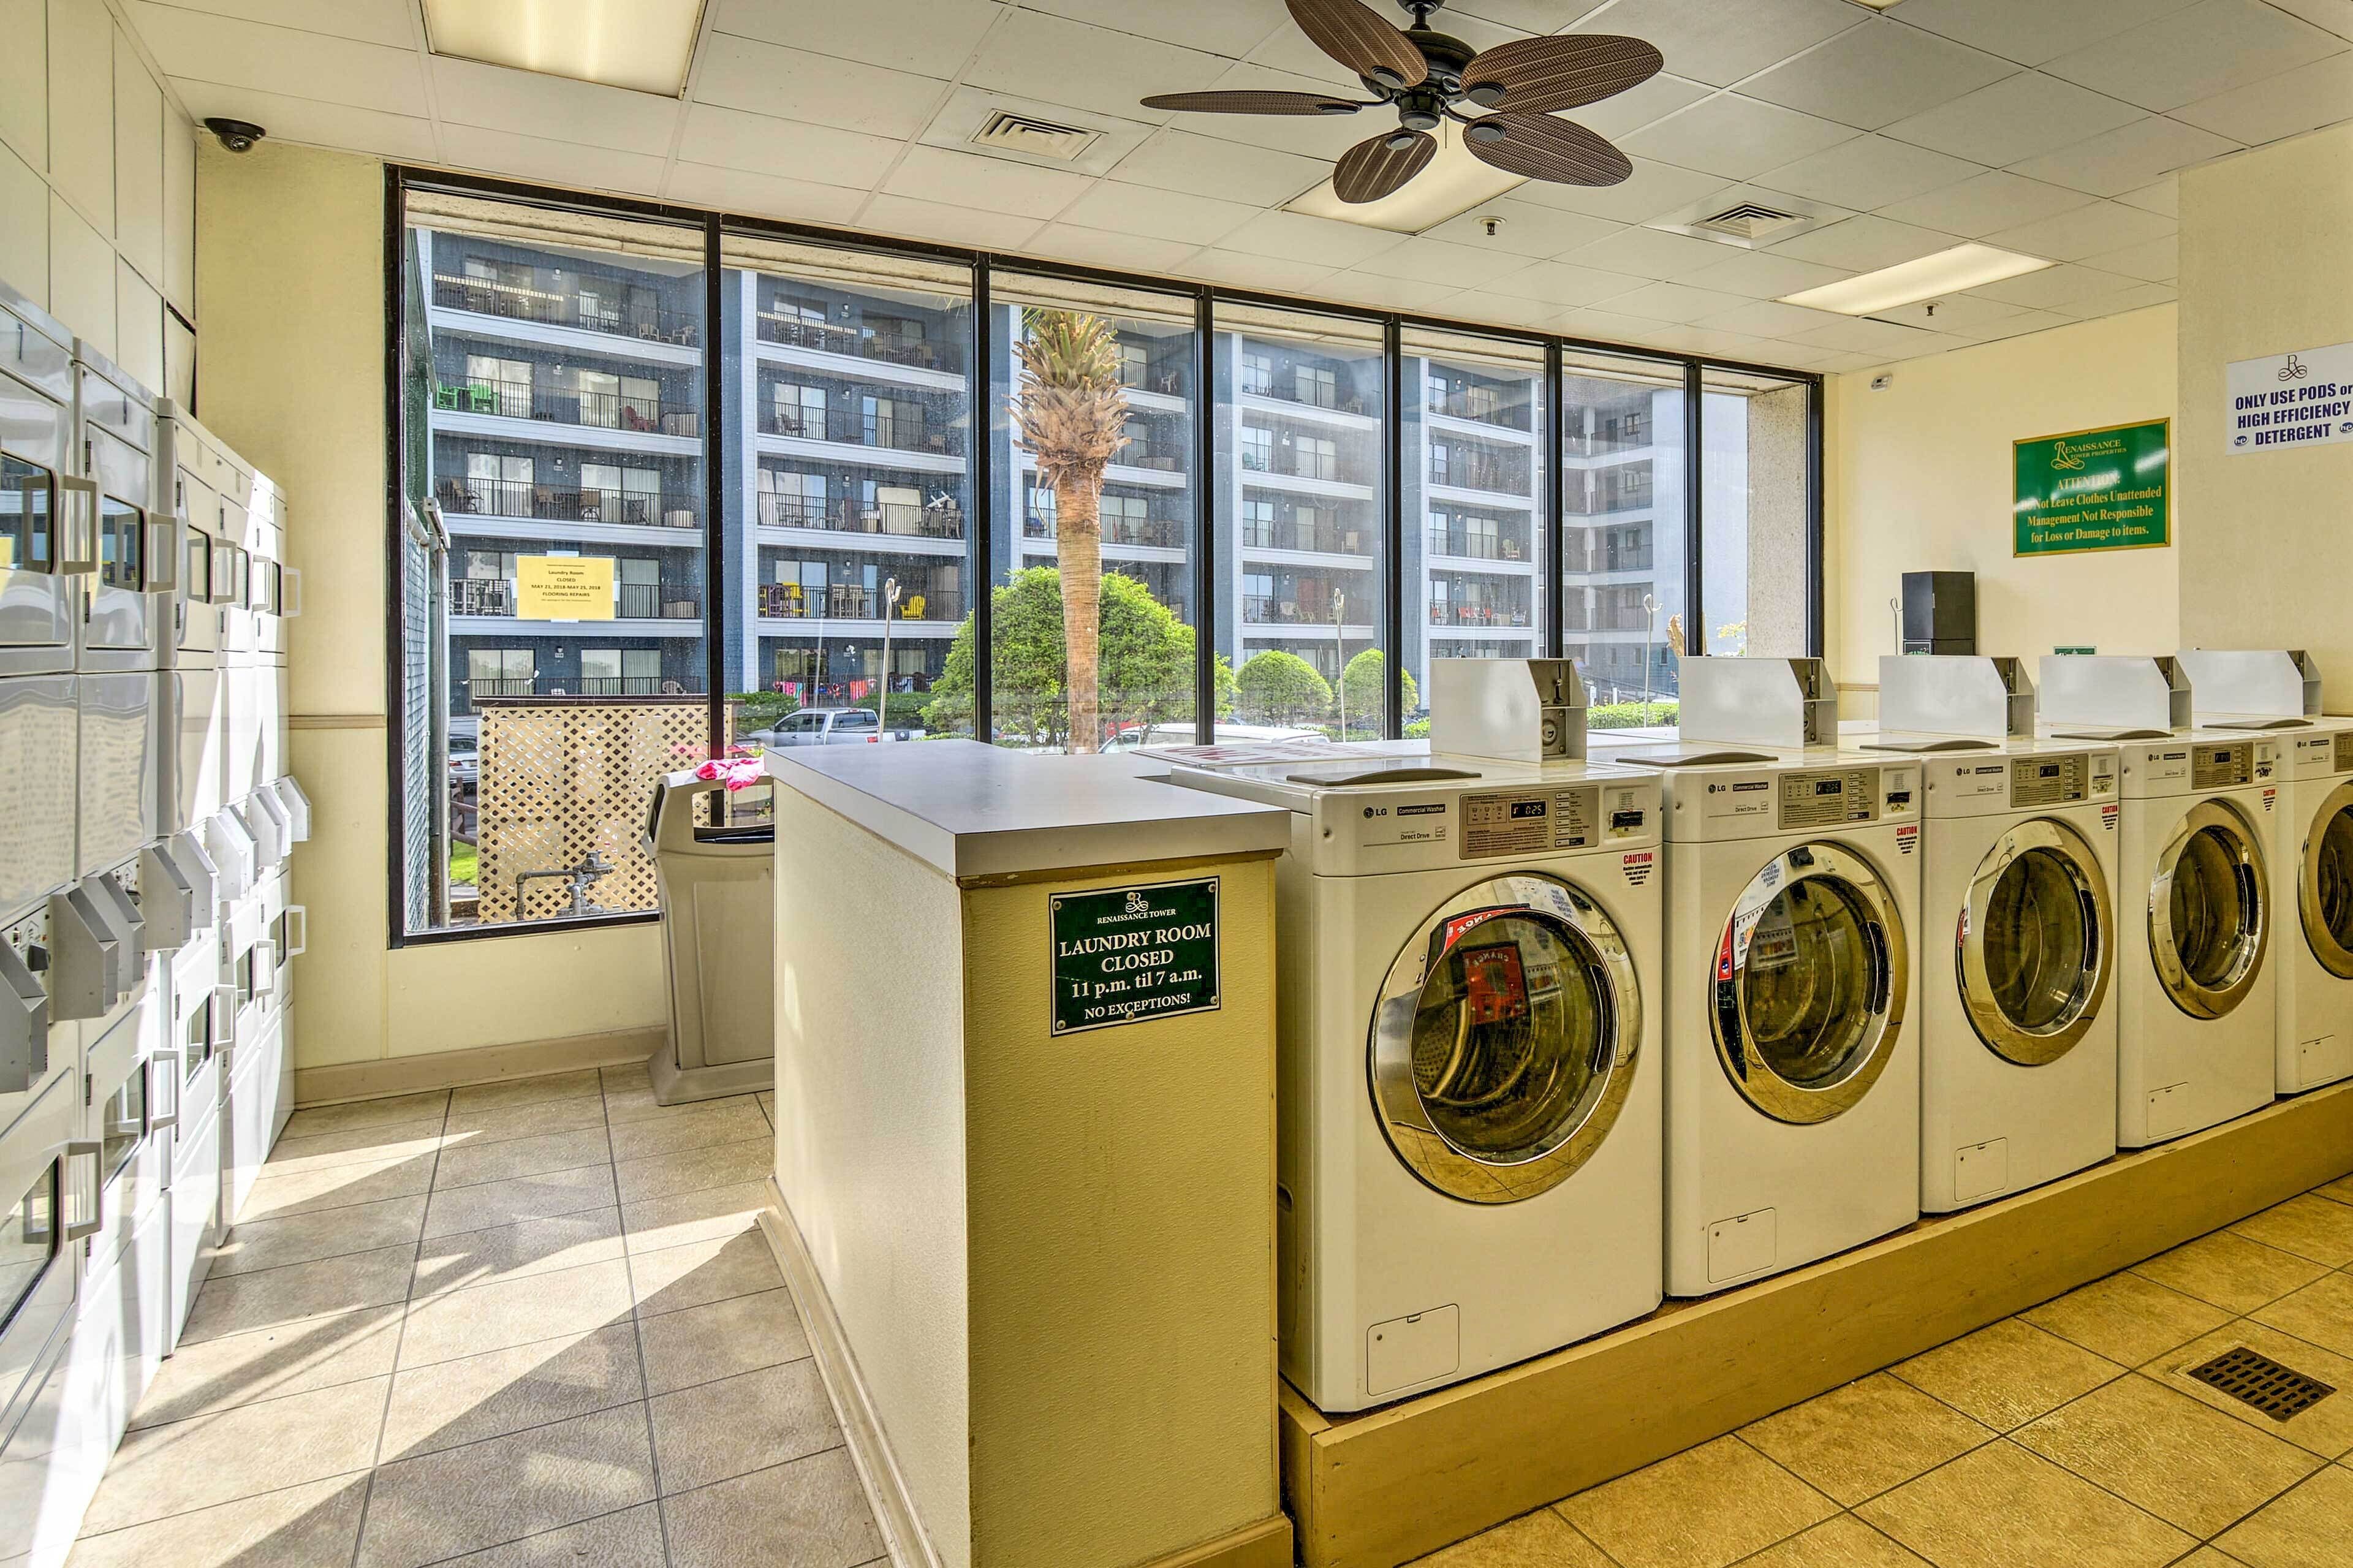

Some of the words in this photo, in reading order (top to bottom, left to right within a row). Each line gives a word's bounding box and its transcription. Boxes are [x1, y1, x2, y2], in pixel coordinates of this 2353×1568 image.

[2235, 393, 2267, 410] ONLY
[2270, 389, 2295, 405] USE
[2299, 383, 2336, 401] PODS
[2340, 385, 2353, 395] or
[2238, 412, 2270, 429] HIGH
[2274, 401, 2351, 424] EFFICIENCY
[2256, 423, 2331, 445] DETERGENT
[2036, 498, 2050, 509] Not
[2052, 497, 2074, 508] Leave
[2076, 492, 2108, 506] Clothes
[2110, 485, 2162, 502] Unattended
[2028, 513, 2080, 527] Management
[2082, 510, 2099, 522] Not
[2100, 505, 2154, 521] Responsible
[2031, 531, 2043, 543] for
[2045, 530, 2063, 542] Loss
[2064, 532, 2074, 541] or
[2075, 527, 2110, 540] Damage
[2112, 526, 2121, 537] to
[2123, 525, 2149, 536] items.
[1896, 826, 1917, 836] CAUTION
[1624, 852, 1652, 865] CAUTION
[1097, 912, 1148, 925] RENAISSANCE
[1149, 908, 1176, 918] TOWER
[1059, 931, 1151, 957] LAUNDRY
[1155, 923, 1211, 944] ROOM
[1101, 949, 1174, 973] CLOSED
[1072, 982, 1089, 998] 11
[1094, 980, 1131, 999] p.m.
[1134, 971, 1153, 989] til
[1156, 971, 1165, 985] 7
[1169, 969, 1202, 983] a.m.
[1084, 1007, 1105, 1020] NO
[1107, 993, 1191, 1016] EXCEPTIONS!
